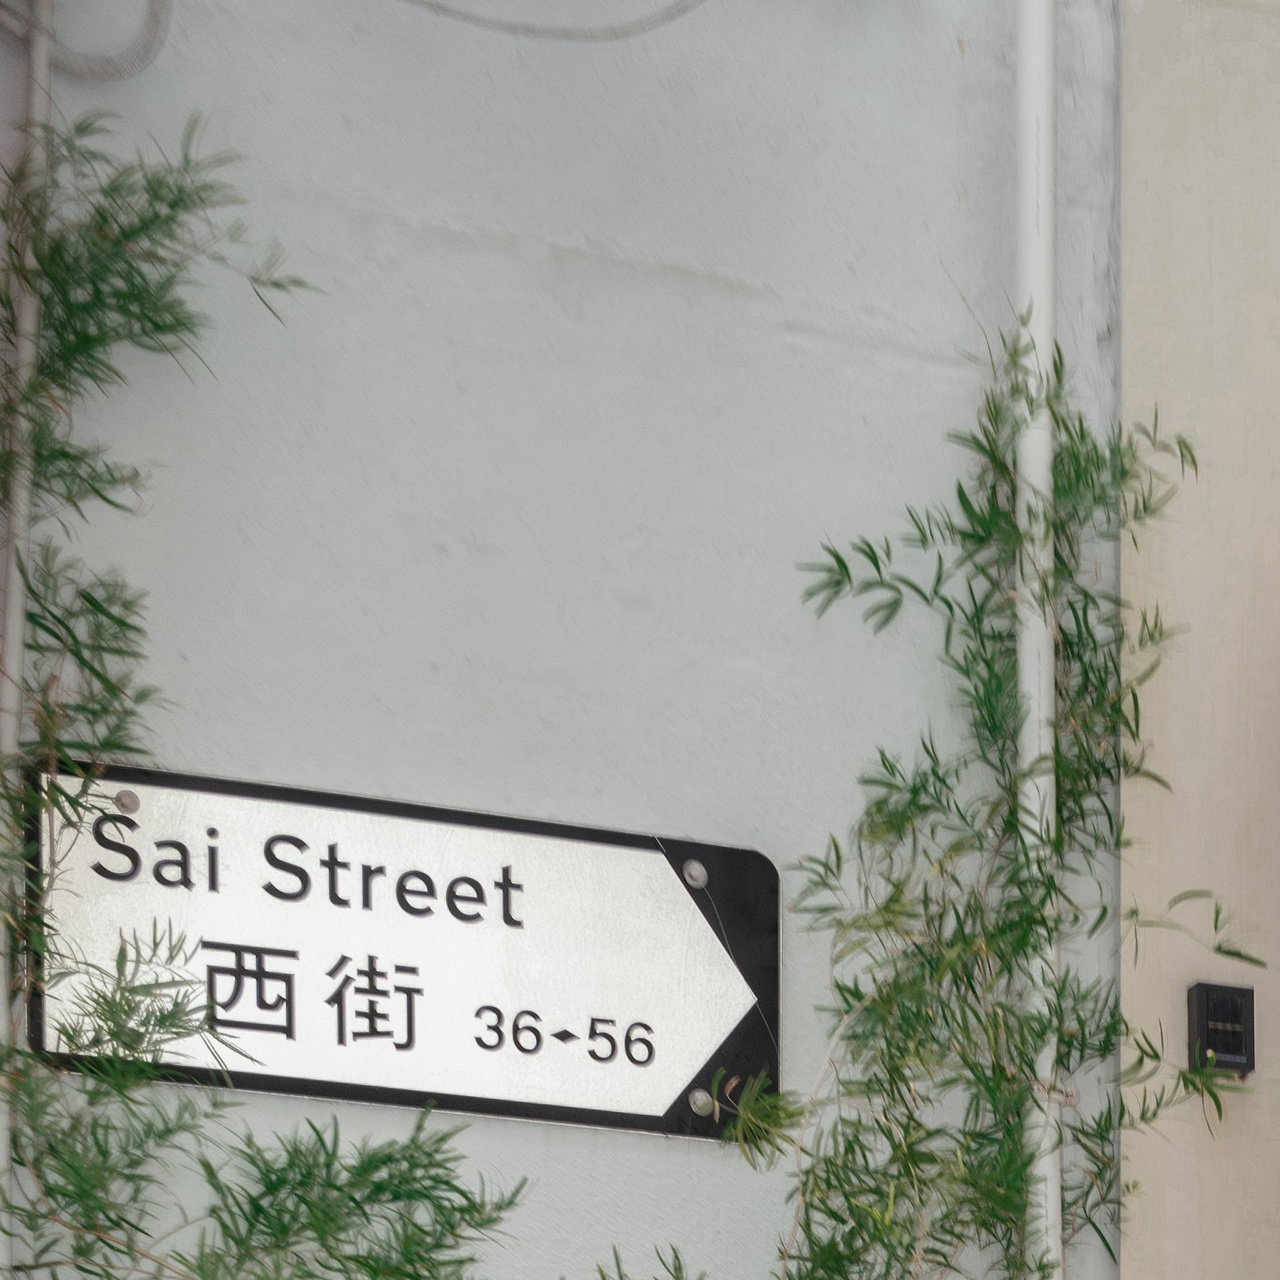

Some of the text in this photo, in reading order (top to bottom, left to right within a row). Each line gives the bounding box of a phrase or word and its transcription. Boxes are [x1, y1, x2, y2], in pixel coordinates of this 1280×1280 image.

[91, 812, 524, 928] Sai Street
[201, 938, 424, 1051] 西街
